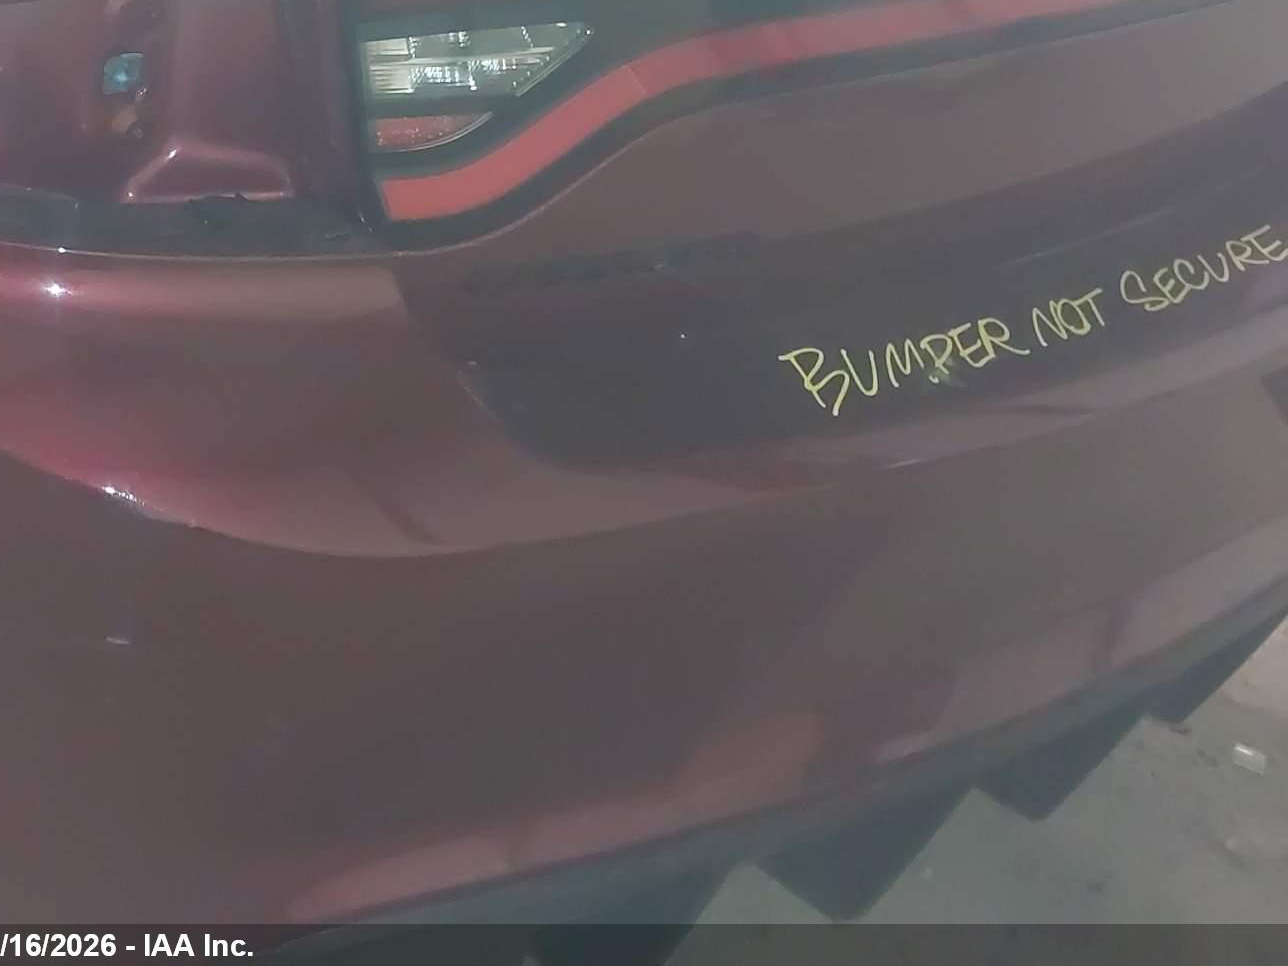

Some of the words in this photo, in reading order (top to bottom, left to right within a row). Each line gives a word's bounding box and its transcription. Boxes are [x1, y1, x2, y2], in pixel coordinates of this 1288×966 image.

[778, 317, 1030, 416] BUMPER
[1032, 288, 1108, 347] NOT
[1120, 225, 1288, 311] SECURE
